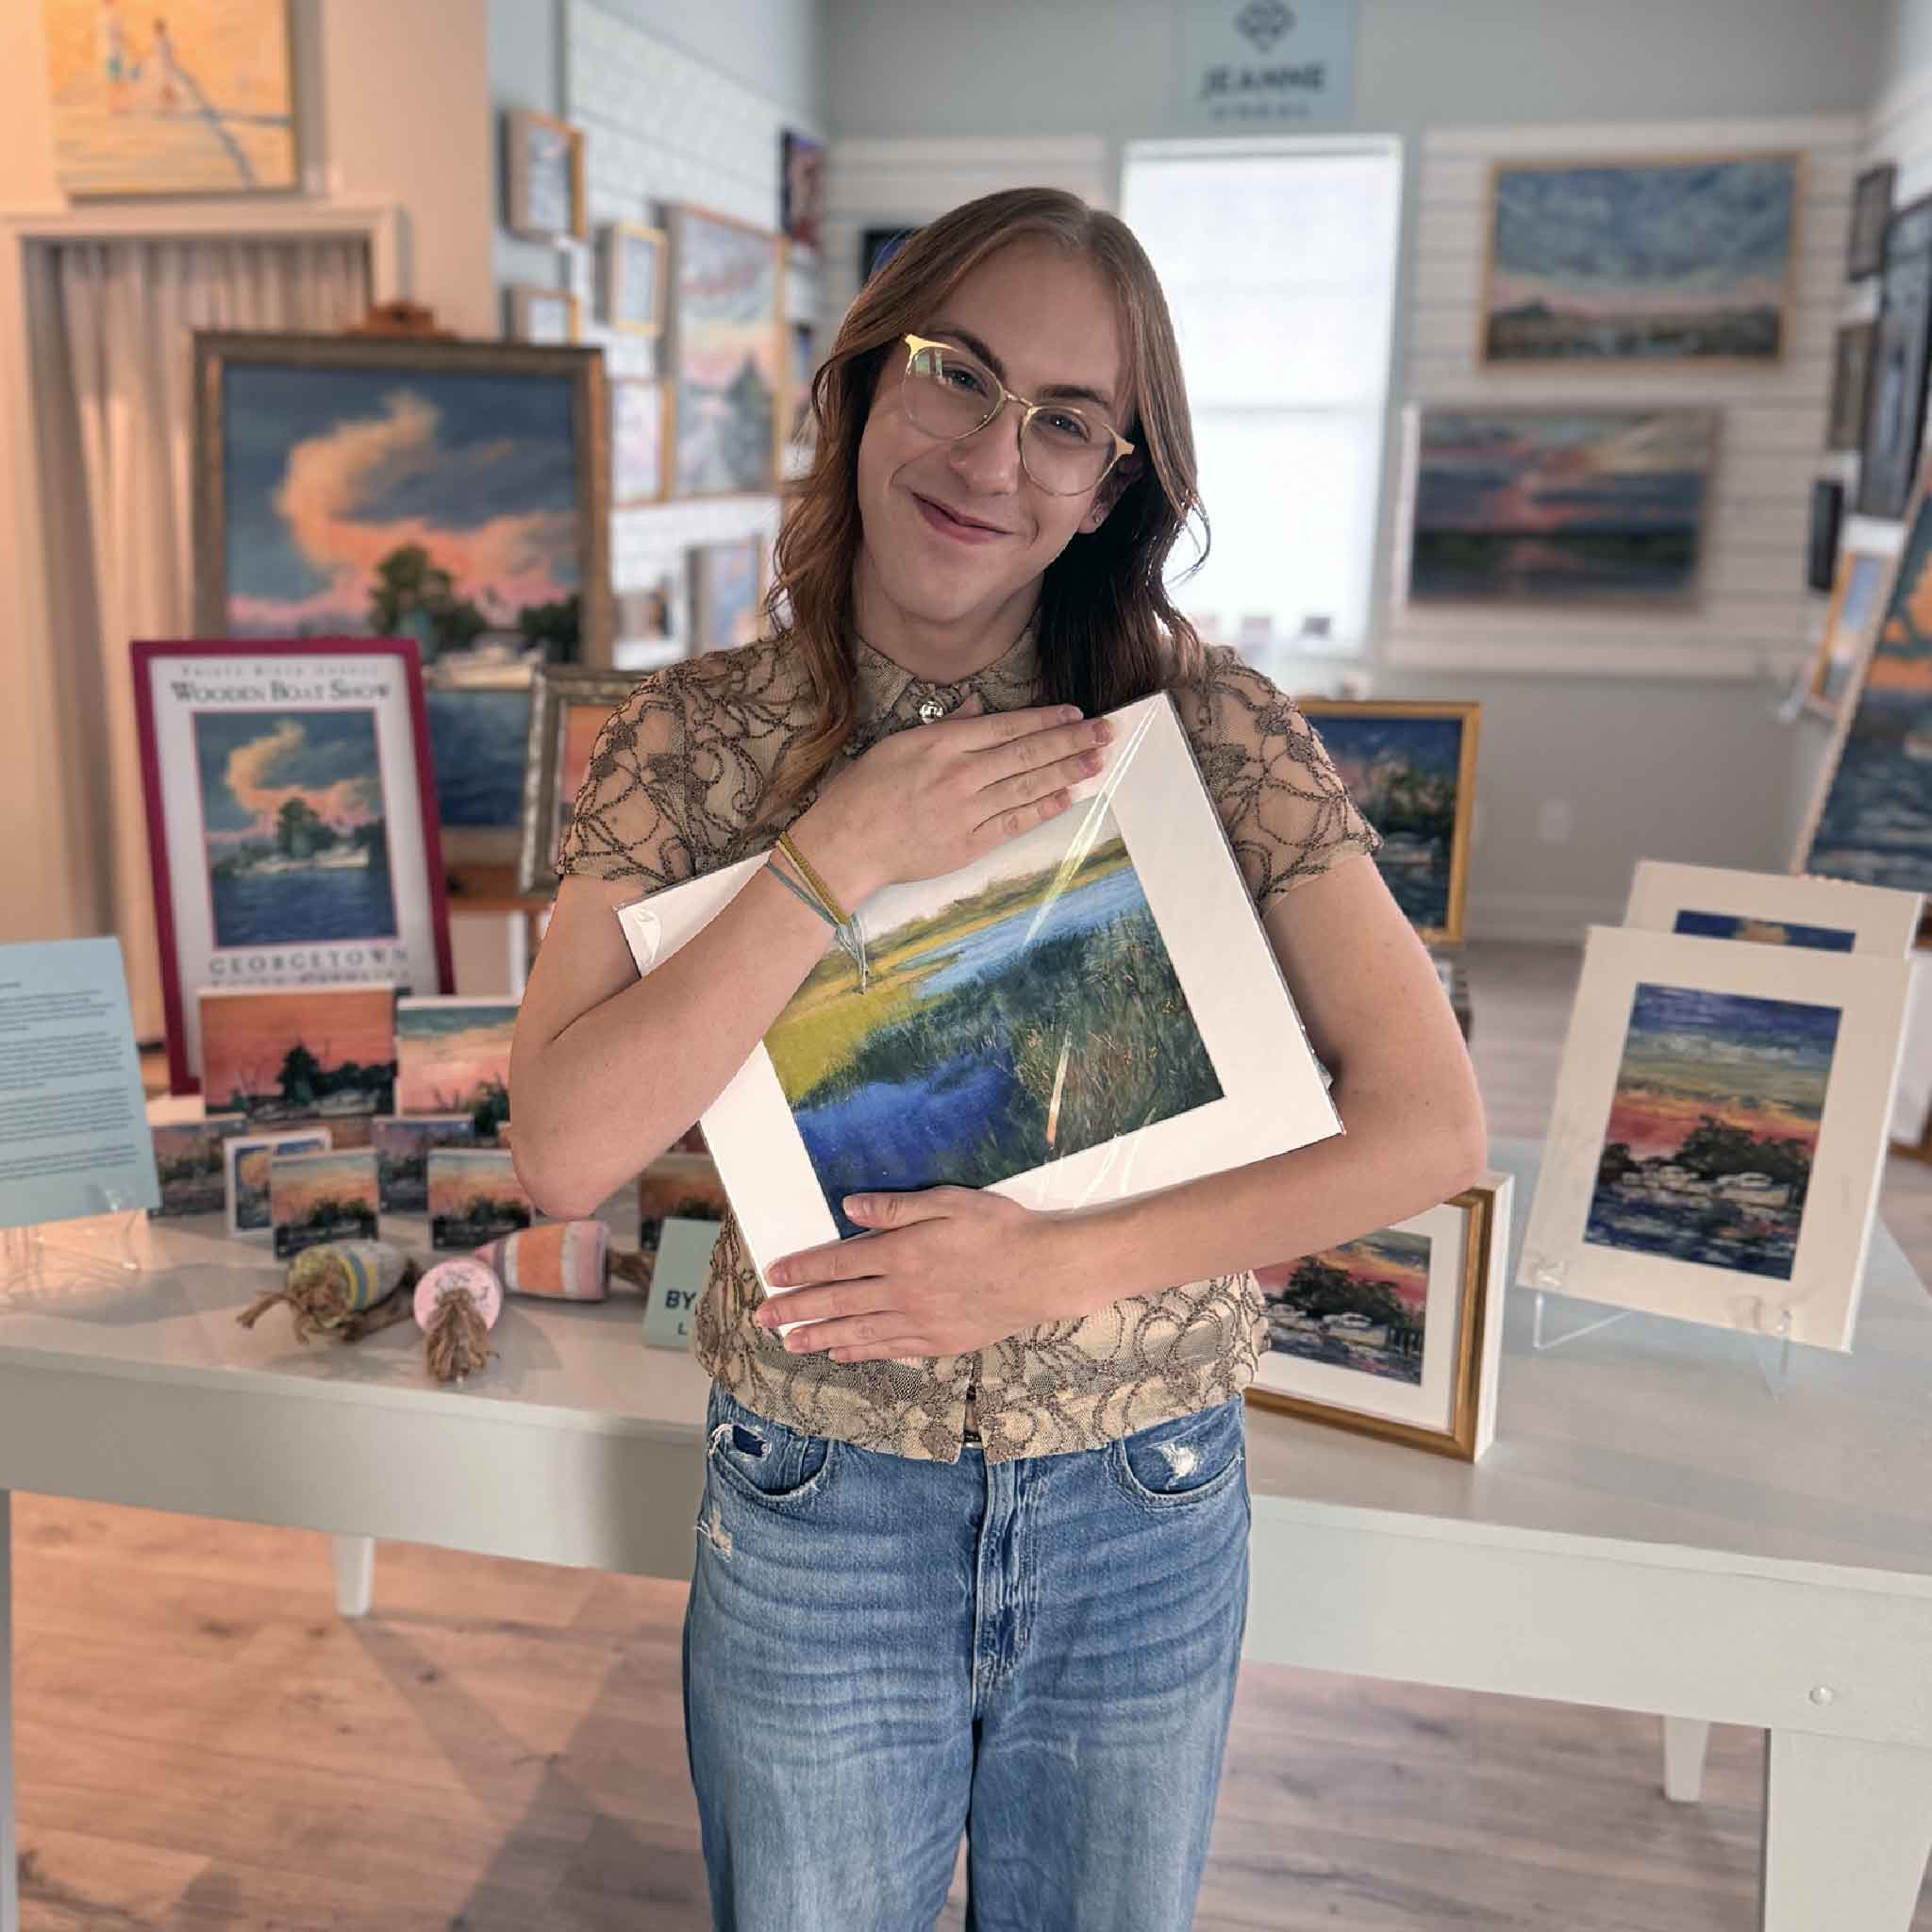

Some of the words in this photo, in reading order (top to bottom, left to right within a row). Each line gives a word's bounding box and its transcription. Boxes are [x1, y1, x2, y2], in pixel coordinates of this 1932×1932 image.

[169, 680, 265, 703] WOODEN
[270, 678, 323, 703] BOAT
[329, 676, 391, 701] SHOW
[208, 948, 409, 975] GEORGETOWN
[665, 1290, 697, 1310] BY
